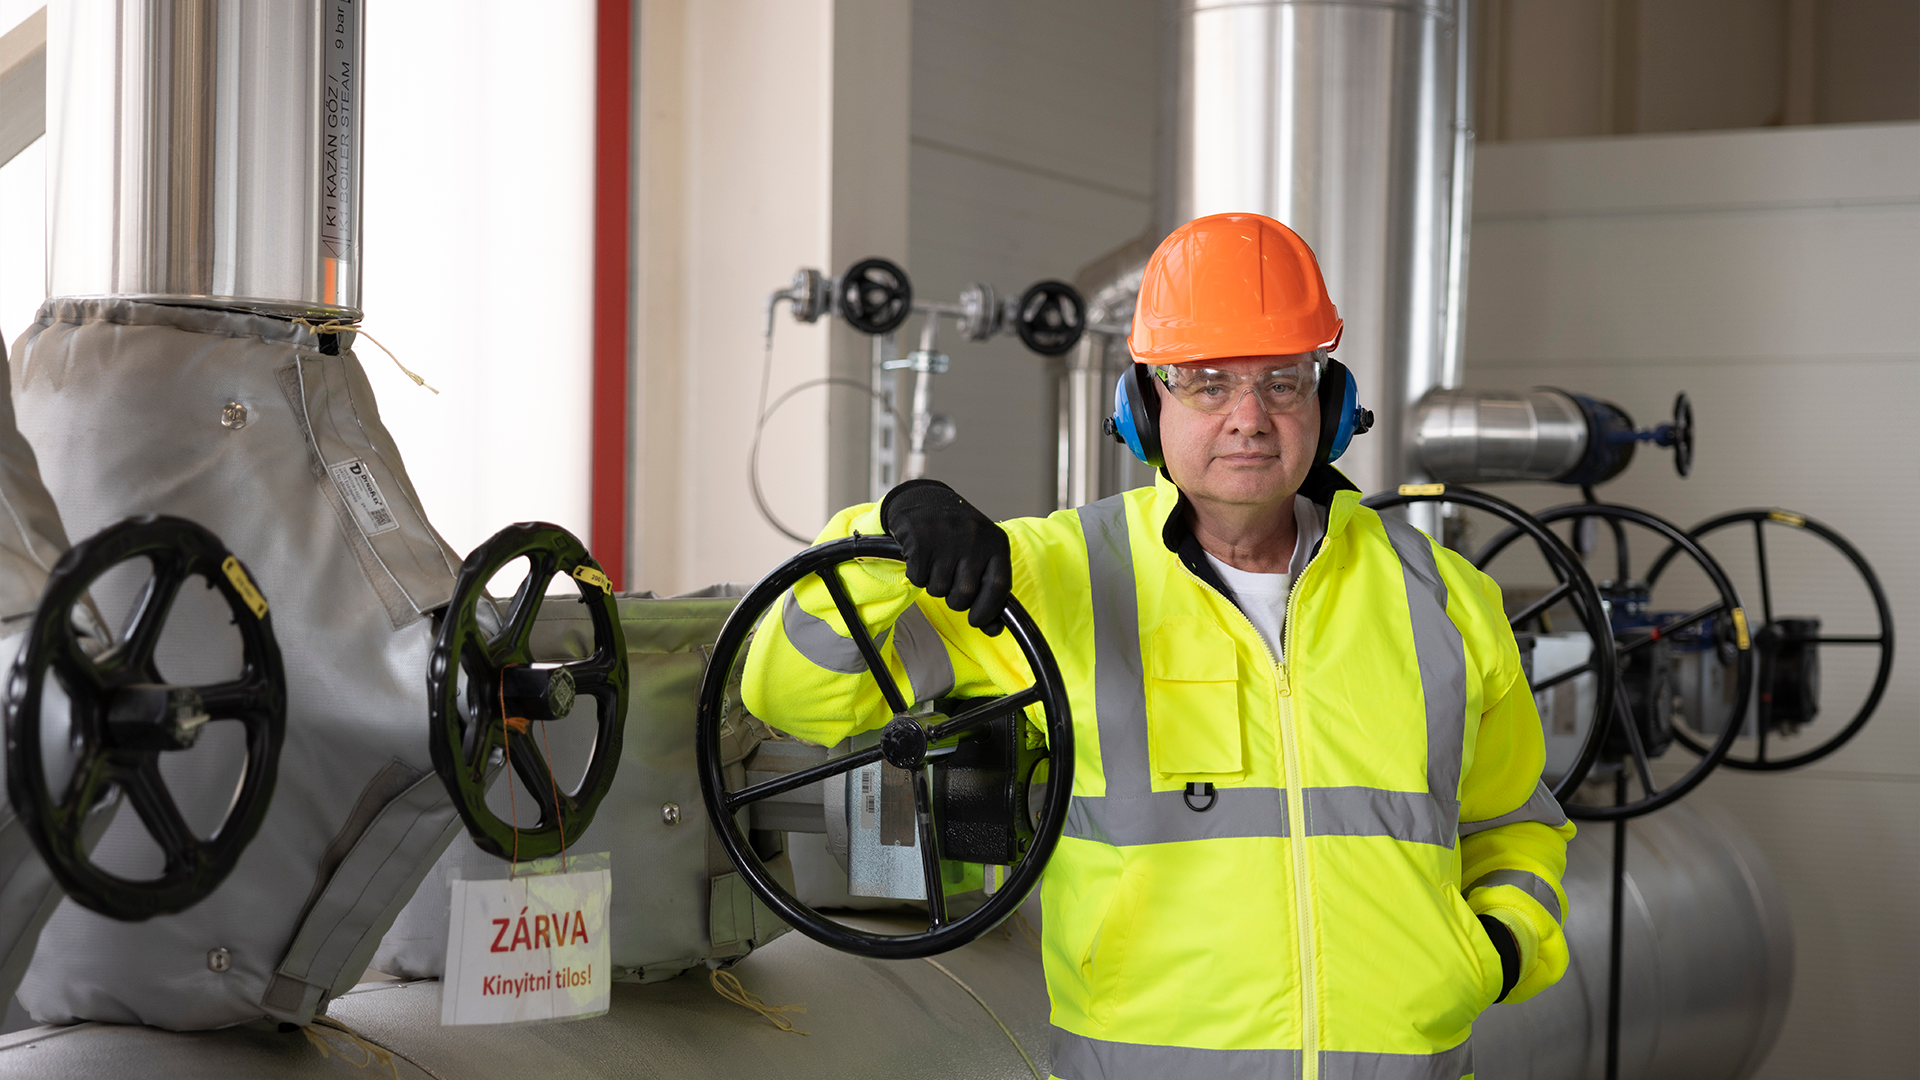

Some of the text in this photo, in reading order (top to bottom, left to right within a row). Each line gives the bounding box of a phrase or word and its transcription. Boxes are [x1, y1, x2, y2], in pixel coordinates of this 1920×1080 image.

[335, 6, 345, 49] 9 bar
[326, 86, 338, 128] GŐZ
[325, 134, 338, 198] KAZÁN
[340, 61, 350, 232] K1 BOILER STEAM
[326, 206, 337, 227] K1
[490, 906, 589, 953] ZÁRVA
[483, 964, 591, 999] Kinyitni tilos!
